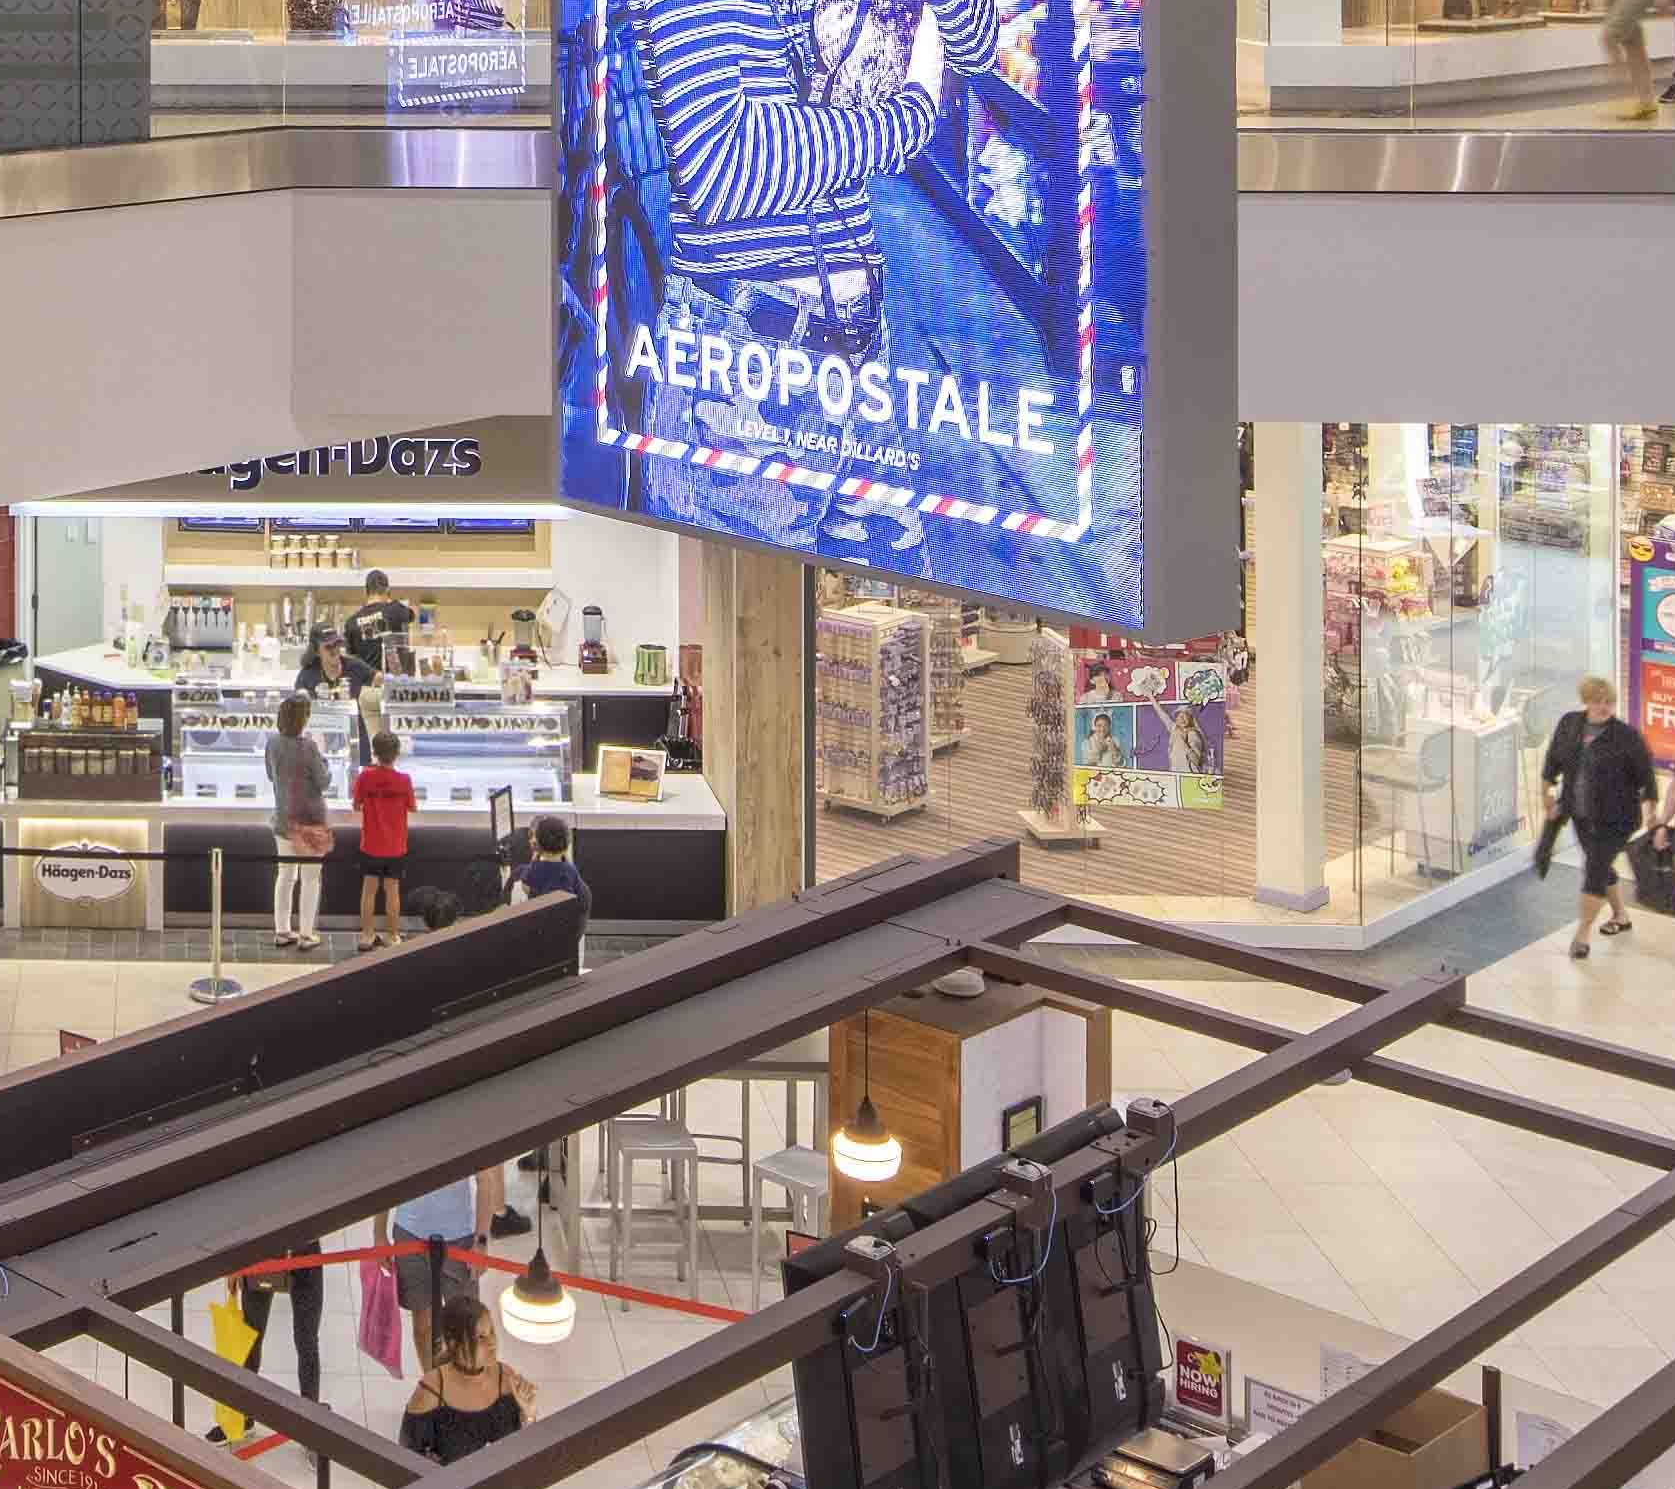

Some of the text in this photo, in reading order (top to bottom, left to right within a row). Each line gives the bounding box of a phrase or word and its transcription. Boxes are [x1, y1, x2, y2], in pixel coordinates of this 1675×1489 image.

[625, 307, 1056, 454] AÉROPOSTALE
[738, 421, 779, 444] LEVEL
[797, 430, 838, 454] NEAR
[841, 437, 921, 471] DILLARD'S
[41, 863, 132, 882] Häagen-Dazs
[1179, 1365, 1219, 1388] NOW
[1179, 1377, 1219, 1399] HIRING
[33, 1465, 77, 1486] SINCE
